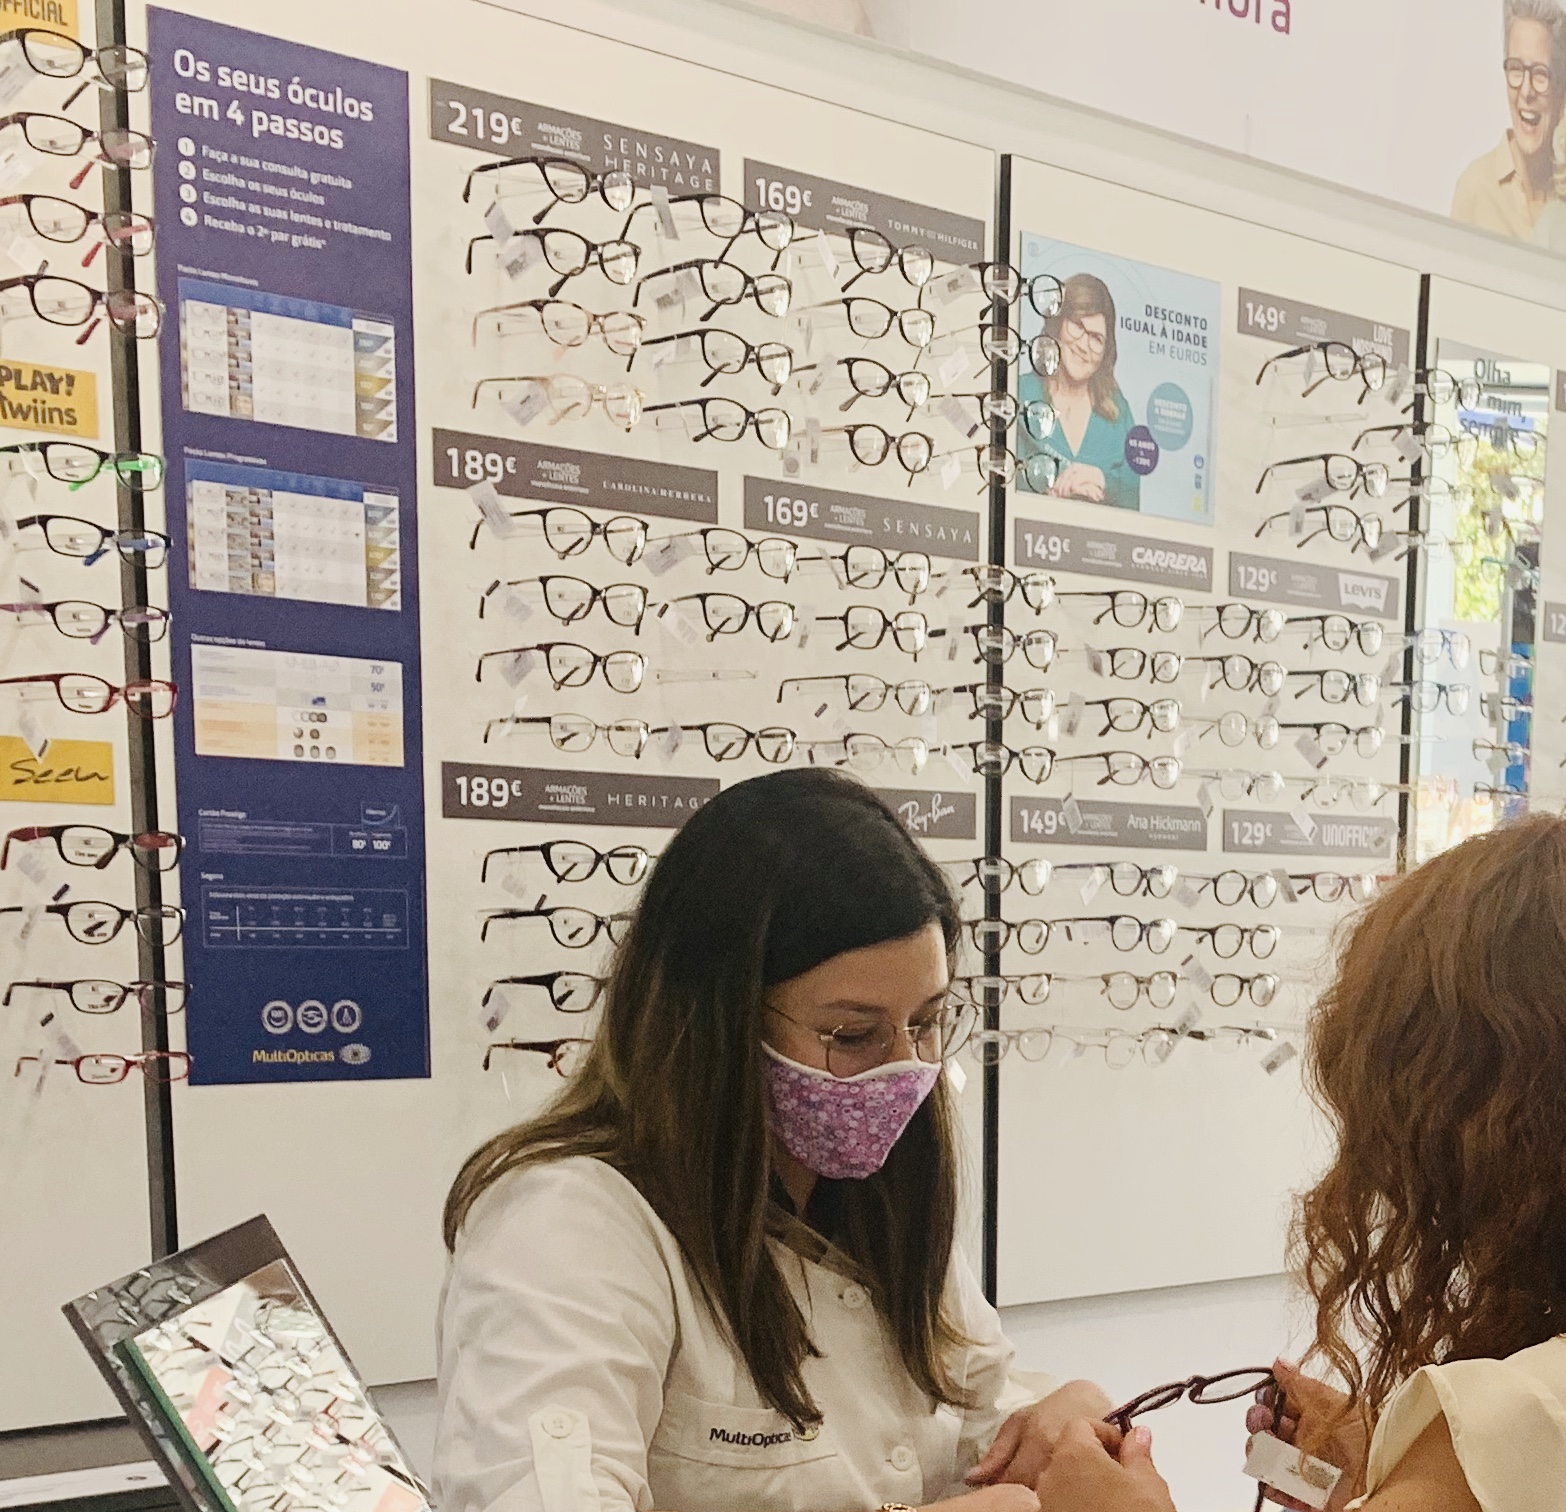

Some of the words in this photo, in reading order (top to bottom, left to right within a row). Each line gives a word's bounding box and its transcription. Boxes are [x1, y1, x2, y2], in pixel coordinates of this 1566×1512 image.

[174, 49, 211, 82] Os
[217, 66, 280, 99] seus
[287, 76, 374, 122] óculos
[175, 92, 219, 121] em
[226, 100, 245, 126] 4
[252, 109, 344, 149] passos
[448, 100, 523, 145] 219€
[202, 144, 228, 162] Faça
[240, 156, 260, 168] sua
[262, 160, 308, 180] consulta
[310, 171, 353, 190] gratuita
[603, 133, 713, 175] SENSAYA
[202, 168, 246, 188] Escolha
[248, 180, 262, 192] os
[263, 183, 288, 198] seus
[290, 187, 325, 206] óculos
[604, 154, 713, 192] HERITAGE
[755, 177, 812, 215] 169€
[203, 191, 246, 211] Escolha
[248, 203, 262, 215] as
[263, 205, 288, 220] suas
[290, 209, 323, 228] lentes
[333, 219, 392, 242] tratamento
[204, 214, 245, 235] Receba
[271, 230, 289, 244] par
[888, 219, 926, 237] TOMMY
[937, 233, 978, 251] HILFIGER
[1120, 315, 1157, 337] IGUAL
[1160, 322, 1168, 340] À
[1172, 328, 1208, 349] IDADE
[1145, 304, 1207, 331] DESCONTO
[1246, 302, 1287, 332] 149€
[1373, 324, 1394, 346] LOVE
[1149, 340, 1166, 356] EM
[1169, 345, 1207, 366] EUROS
[1475, 358, 1511, 385] Olha
[446, 447, 517, 484] 189€
[603, 480, 657, 497] CAROLINA
[659, 486, 712, 504] HERRERA
[763, 495, 819, 527] 169€
[883, 517, 973, 544] SENSAYA
[1024, 532, 1071, 562] 149€
[1131, 547, 1208, 575] CARRERA
[1238, 565, 1277, 593] 129€
[456, 775, 522, 808] 189€
[1127, 814, 1148, 829] Ana
[1150, 816, 1201, 833] Hickmann
[1231, 822, 1273, 846] 129€
[253, 1049, 335, 1065] MultiOpticas
